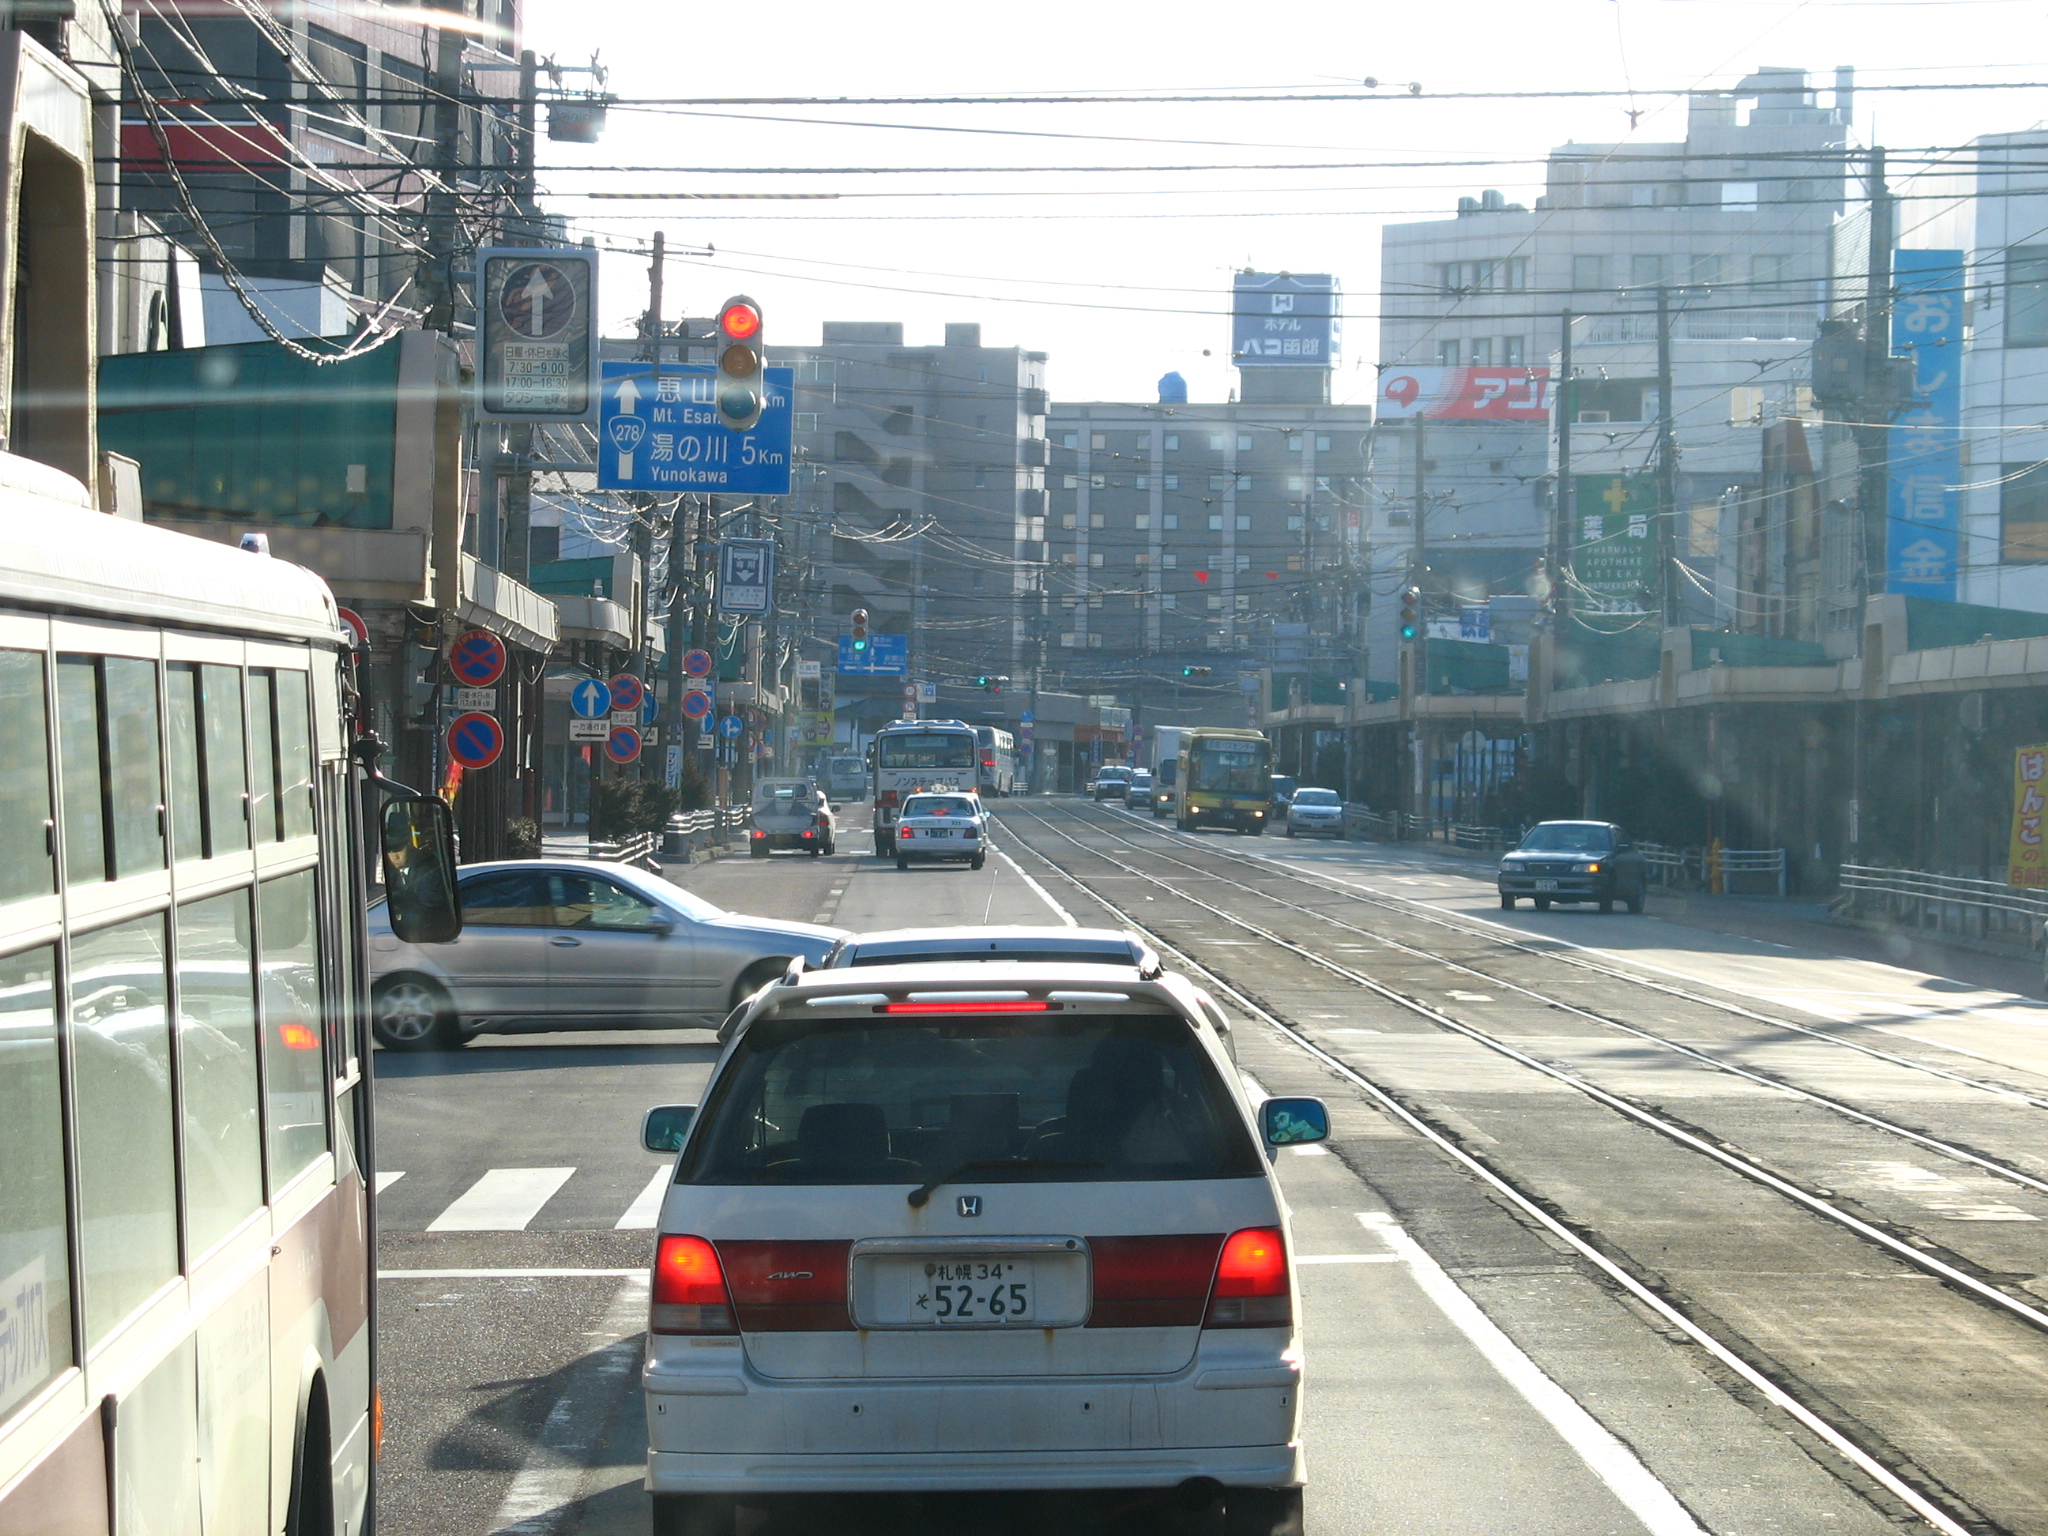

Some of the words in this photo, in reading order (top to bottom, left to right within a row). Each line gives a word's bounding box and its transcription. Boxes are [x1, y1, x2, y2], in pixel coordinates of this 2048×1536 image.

[1264, 318, 1302, 331] ホテル
[655, 376, 718, 405] 恵山
[653, 407, 677, 423] Mt.
[616, 424, 640, 442] 278
[1900, 294, 1950, 584] おしま信金
[650, 433, 728, 463] 湯の川
[651, 466, 728, 483] Yunokawa
[1587, 545, 1643, 555] PHARMACY
[1586, 556, 1643, 567] APOTHEKE
[937, 1264, 973, 1281] 札幌
[976, 1264, 1003, 1280] 34
[915, 1293, 930, 1310] そ
[935, 1283, 1028, 1317] 52-65
